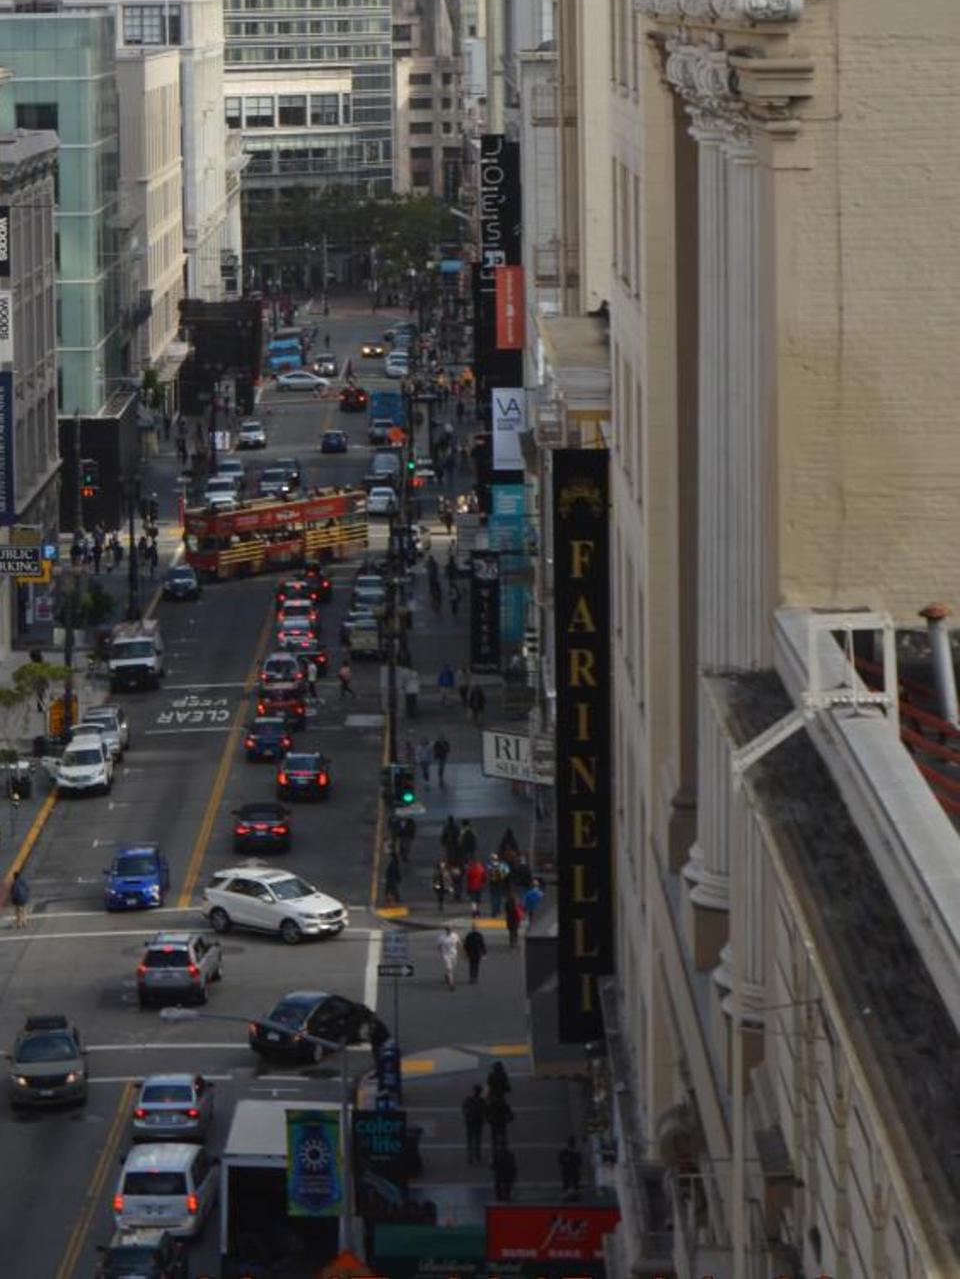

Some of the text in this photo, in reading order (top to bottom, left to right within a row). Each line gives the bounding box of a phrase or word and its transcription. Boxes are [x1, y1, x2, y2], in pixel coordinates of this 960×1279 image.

[156, 709, 231, 724] CLEAR
[568, 539, 599, 1013] FARINELLI
[355, 1115, 404, 1134] color
[372, 1135, 403, 1154] life
